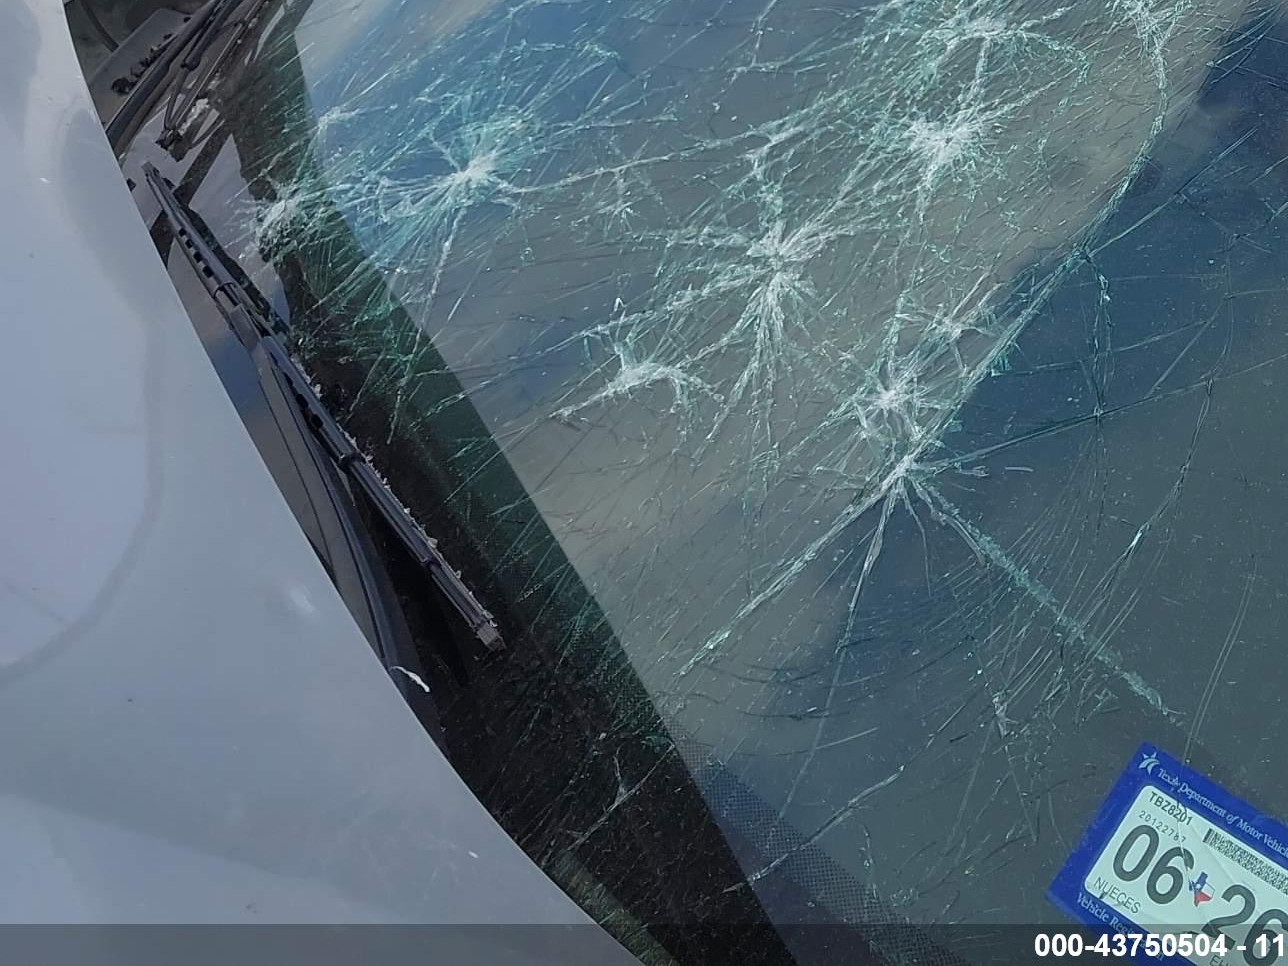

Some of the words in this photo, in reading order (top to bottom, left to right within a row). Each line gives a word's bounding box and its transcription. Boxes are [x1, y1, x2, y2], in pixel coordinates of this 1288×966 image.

[1149, 790, 1193, 826] TBZ8201
[1178, 783, 1227, 817] Department
[1226, 812, 1239, 825] of
[1237, 817, 1263, 842] Motor
[1113, 824, 1195, 905] 06
[1076, 892, 1109, 923] Vehicle
[1093, 876, 1142, 915] NUECES
